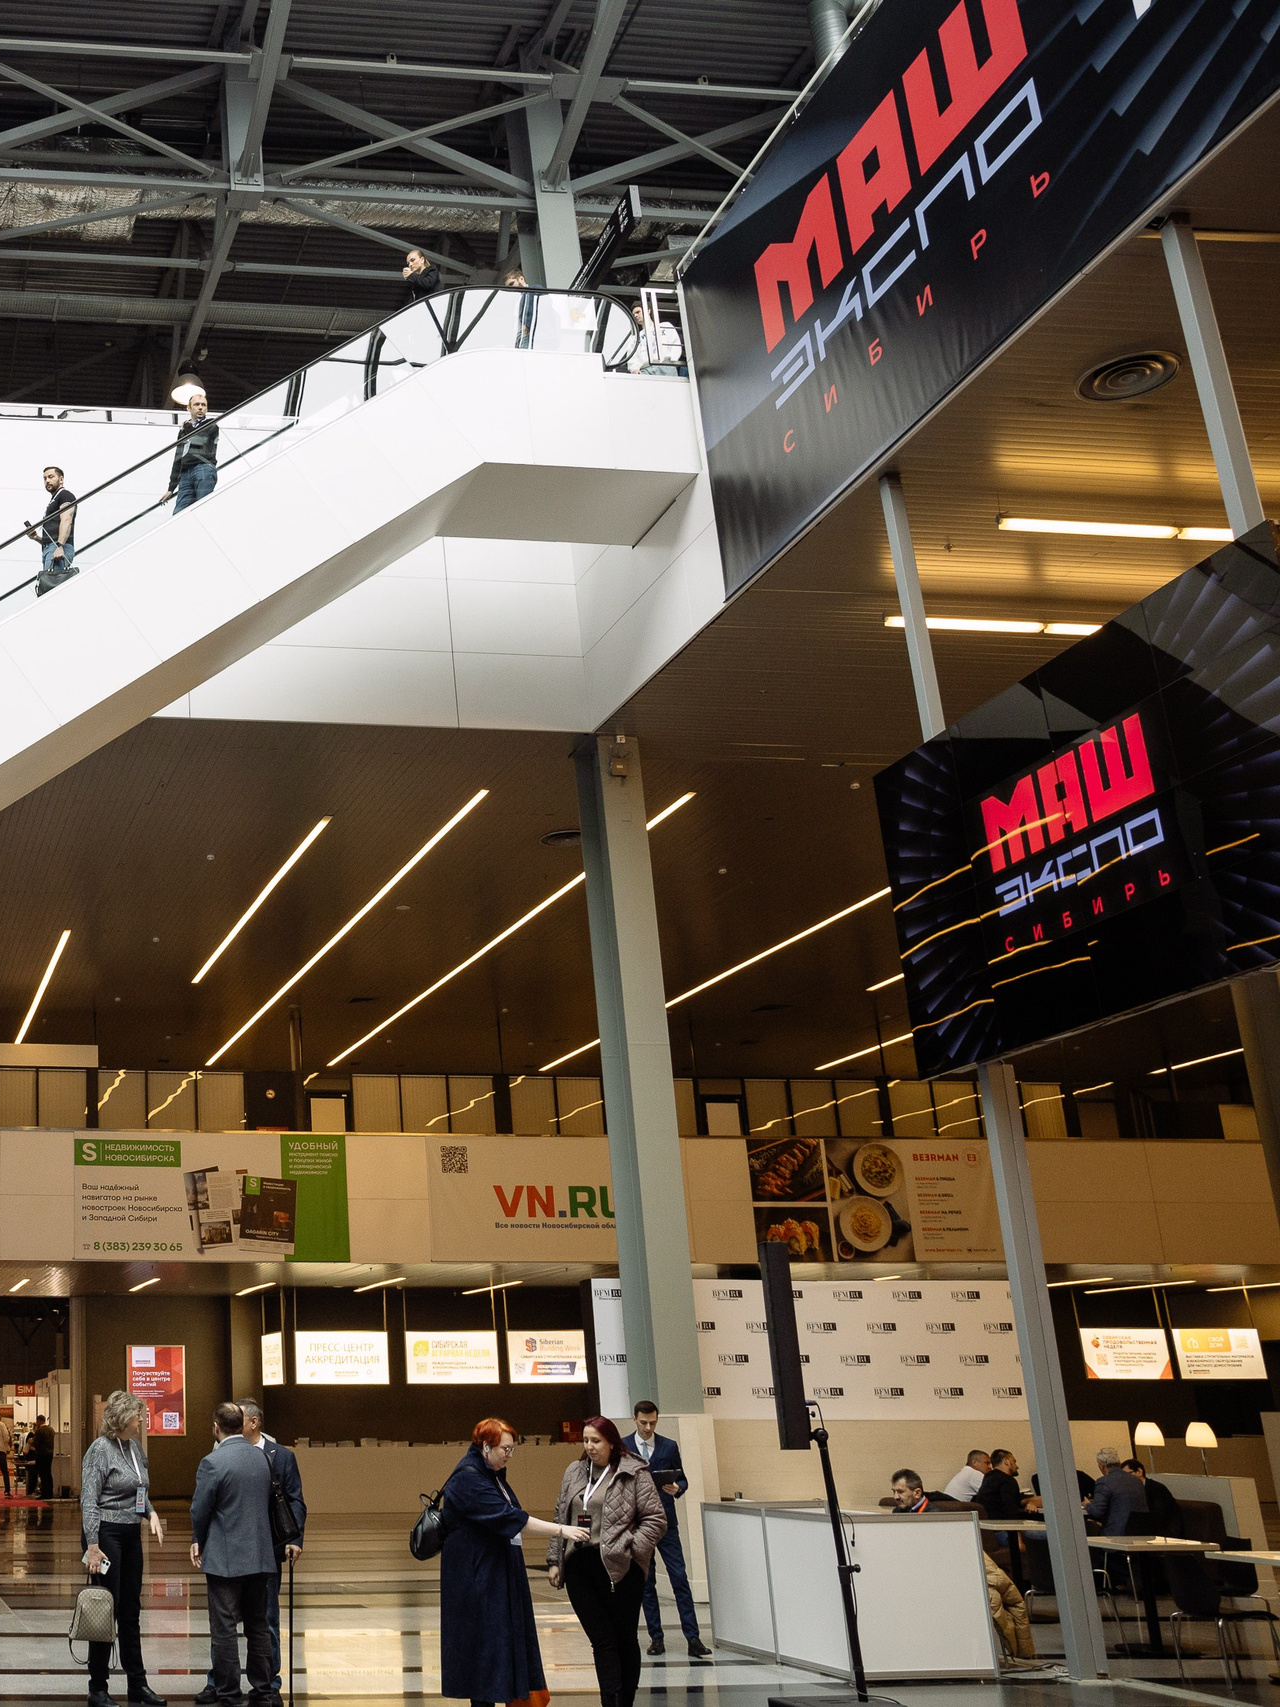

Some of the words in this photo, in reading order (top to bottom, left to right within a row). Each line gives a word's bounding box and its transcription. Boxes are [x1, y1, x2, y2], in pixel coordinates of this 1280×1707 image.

[753, 0, 1028, 353] МАШ
[770, 77, 1043, 411] ЭКСПО
[782, 170, 1050, 454] СИБИРЬ
[980, 712, 1156, 874] МАШ
[995, 808, 1166, 917] ЭКСПО
[1004, 869, 1171, 952] СИБИРЬ
[105, 1143, 175, 1152] НЕДВИЖИМОСТЬ
[288, 1140, 339, 1151] УДОБНЫЙ
[105, 1154, 175, 1162] НОВОСИБИРСКА
[100, 1184, 140, 1192] надёжный
[81, 1205, 127, 1214] новостроек
[128, 1205, 183, 1213] Новосибирска
[88, 1213, 127, 1222] Западной
[128, 1214, 158, 1223] Сибири
[93, 1241, 100, 1250] 8
[102, 1242, 130, 1252] (383)
[131, 1242, 152, 1251] 239
[153, 1242, 168, 1251] 30
[169, 1242, 183, 1251] 65
